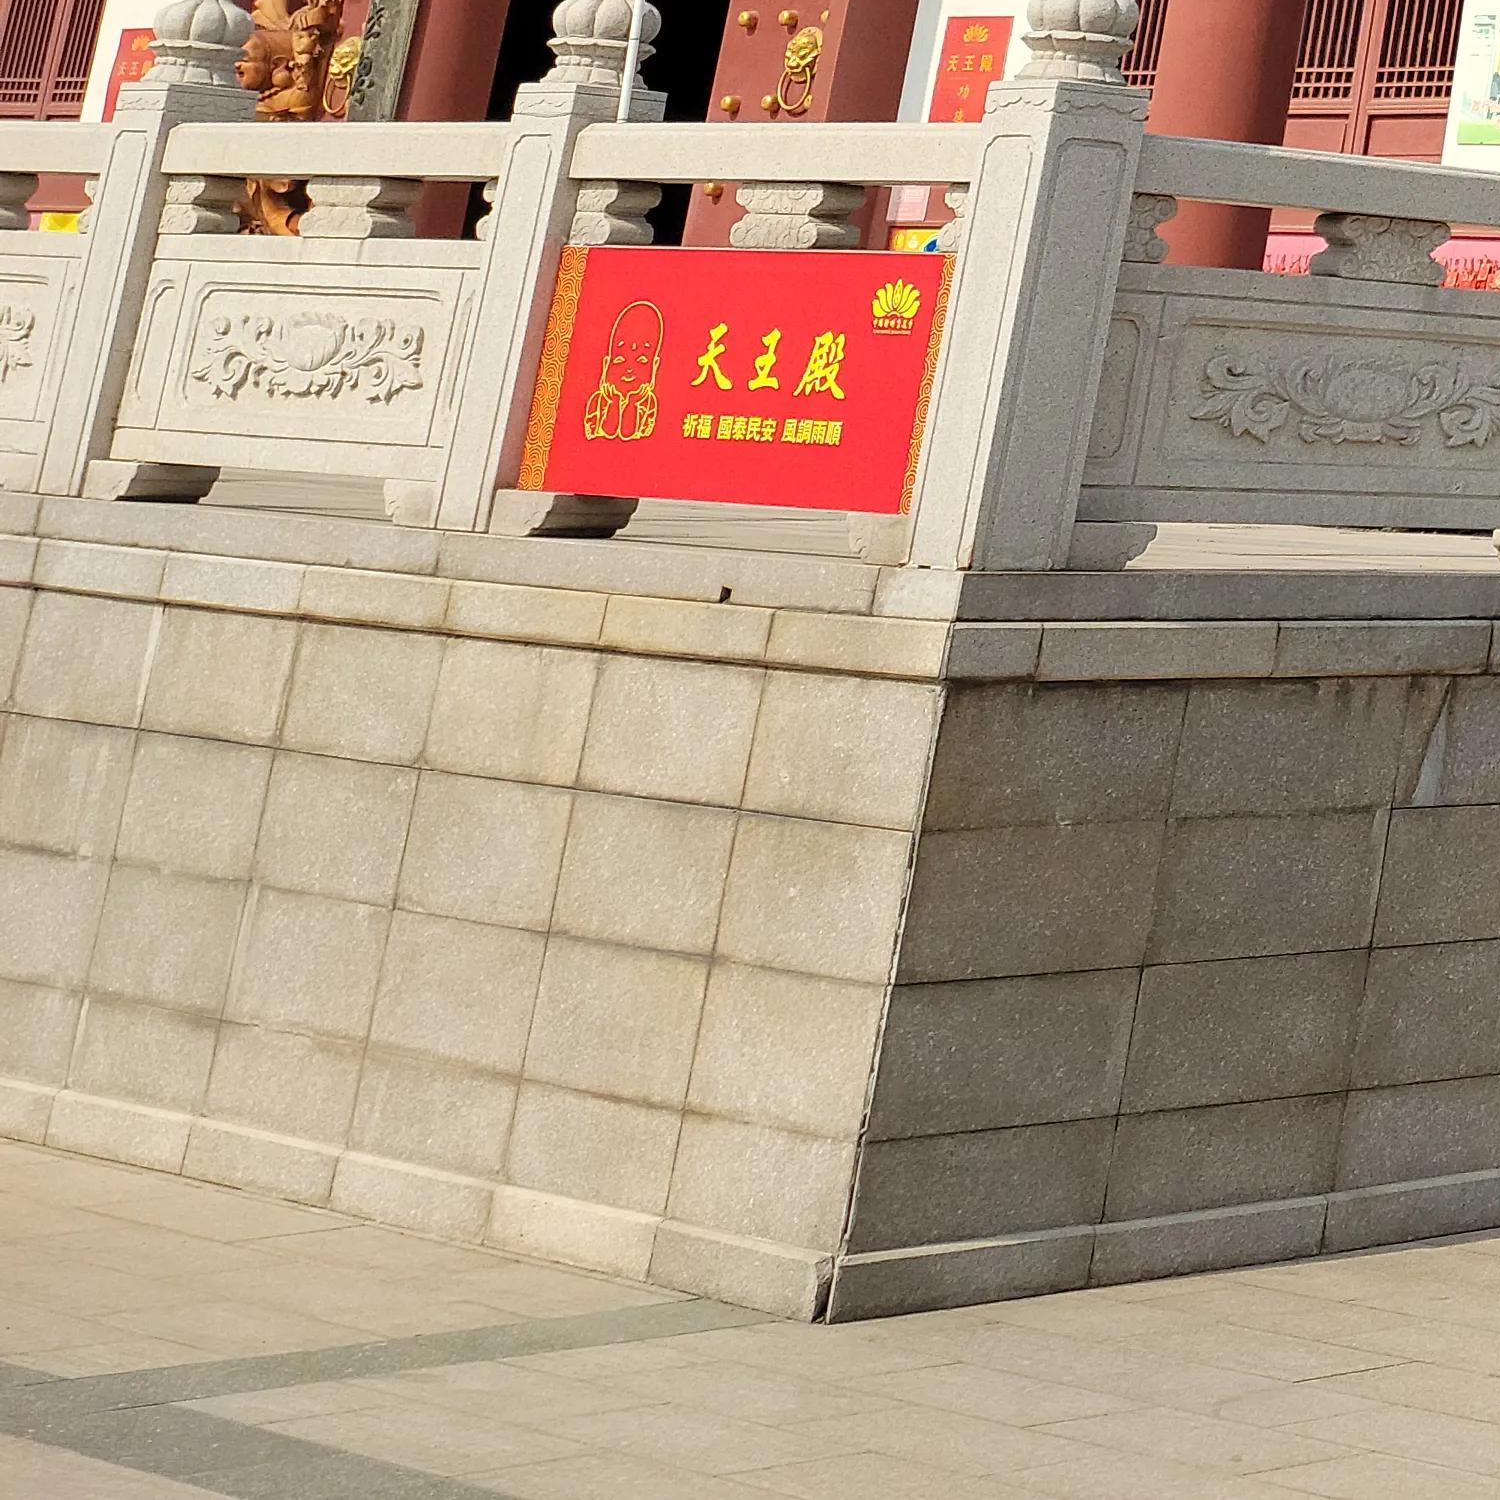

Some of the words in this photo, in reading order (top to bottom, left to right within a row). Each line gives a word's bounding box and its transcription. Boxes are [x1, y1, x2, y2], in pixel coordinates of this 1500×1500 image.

[946, 54, 994, 73] 天王殿
[690, 321, 847, 400] 天王殿
[682, 413, 714, 440] 祈福
[716, 415, 776, 443] 國泰民安
[780, 418, 845, 446] 風調雨順
